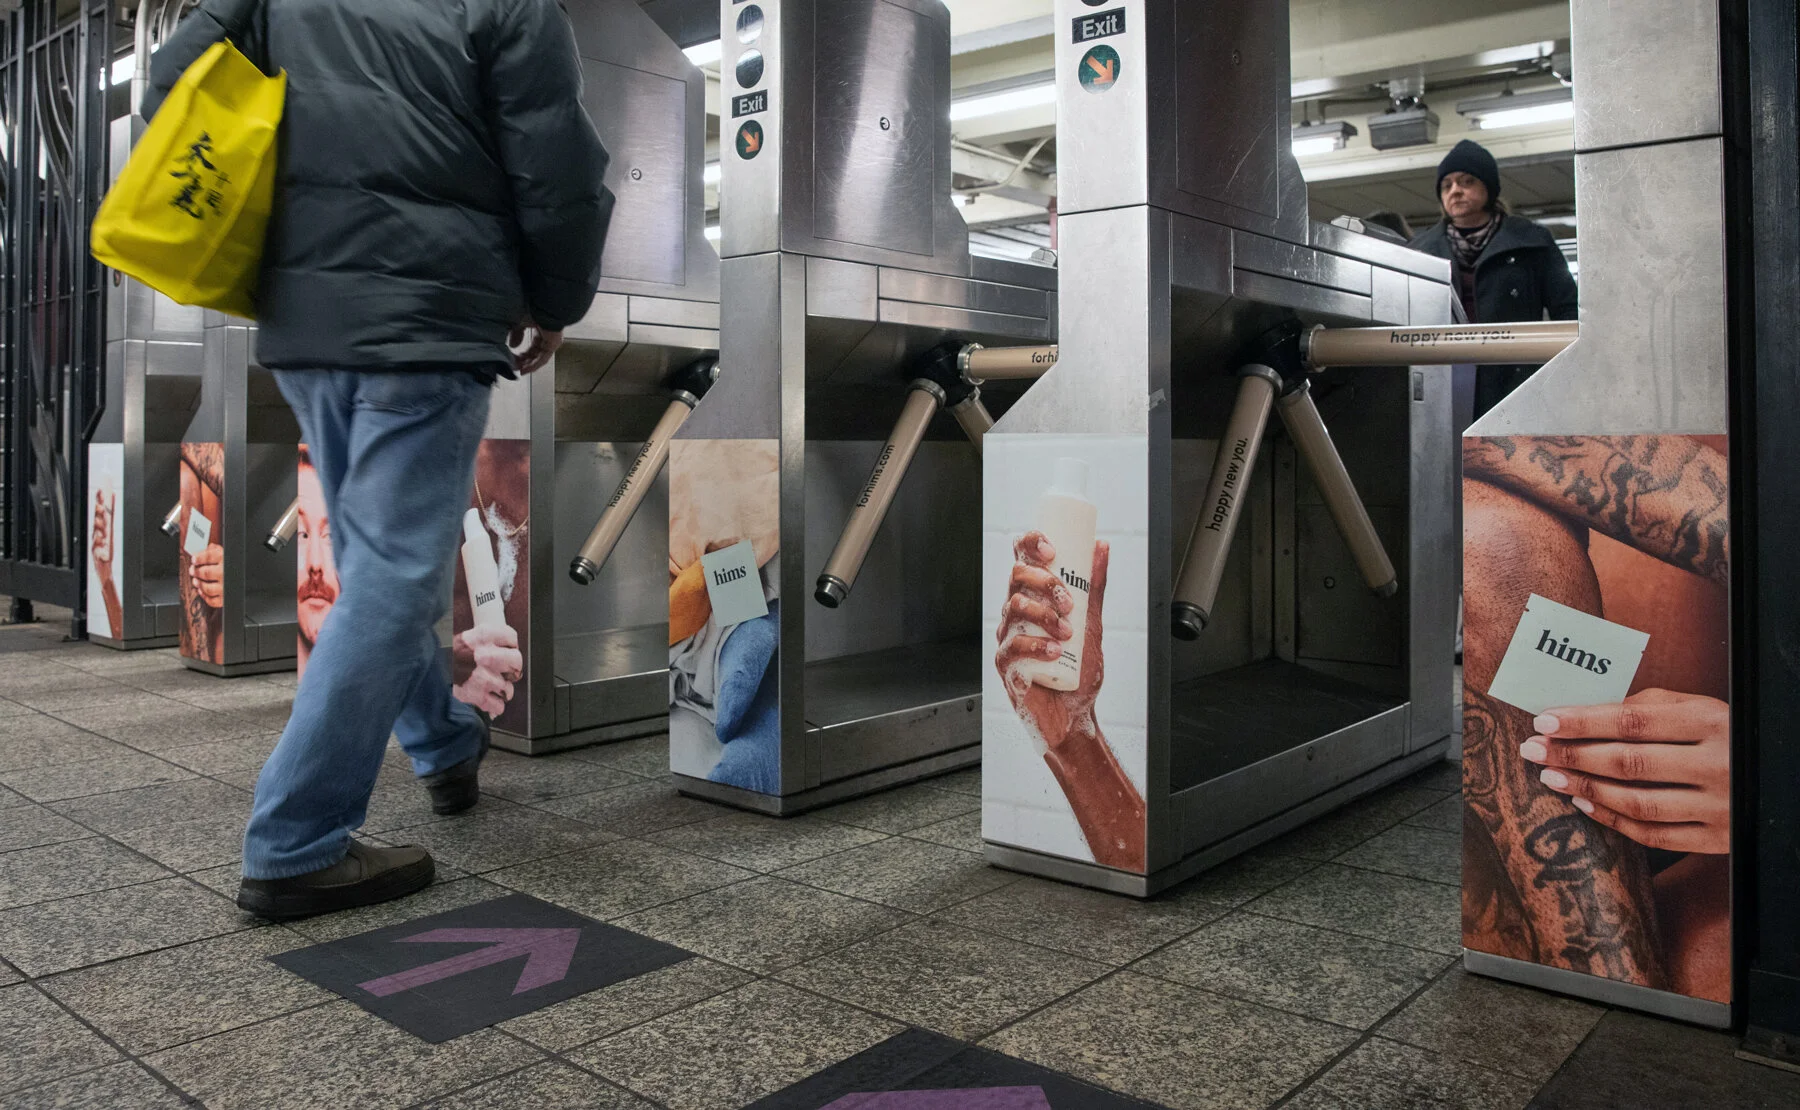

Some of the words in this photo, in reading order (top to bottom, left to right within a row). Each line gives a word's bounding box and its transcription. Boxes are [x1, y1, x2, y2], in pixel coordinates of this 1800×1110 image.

[1082, 14, 1118, 40] Exit
[739, 94, 763, 115] Exit
[1390, 331, 1440, 347] happy
[1444, 331, 1477, 341] new
[1481, 330, 1515, 345] you.
[606, 478, 632, 508] happy
[628, 459, 642, 478] new
[640, 440, 655, 458] you.
[856, 444, 896, 509] forhims.com
[1205, 489, 1234, 532] happy
[1223, 463, 1240, 489] new
[1232, 438, 1248, 464] you.
[713, 565, 747, 586] hims
[475, 590, 496, 607] hims
[1534, 629, 1612, 675] hims
